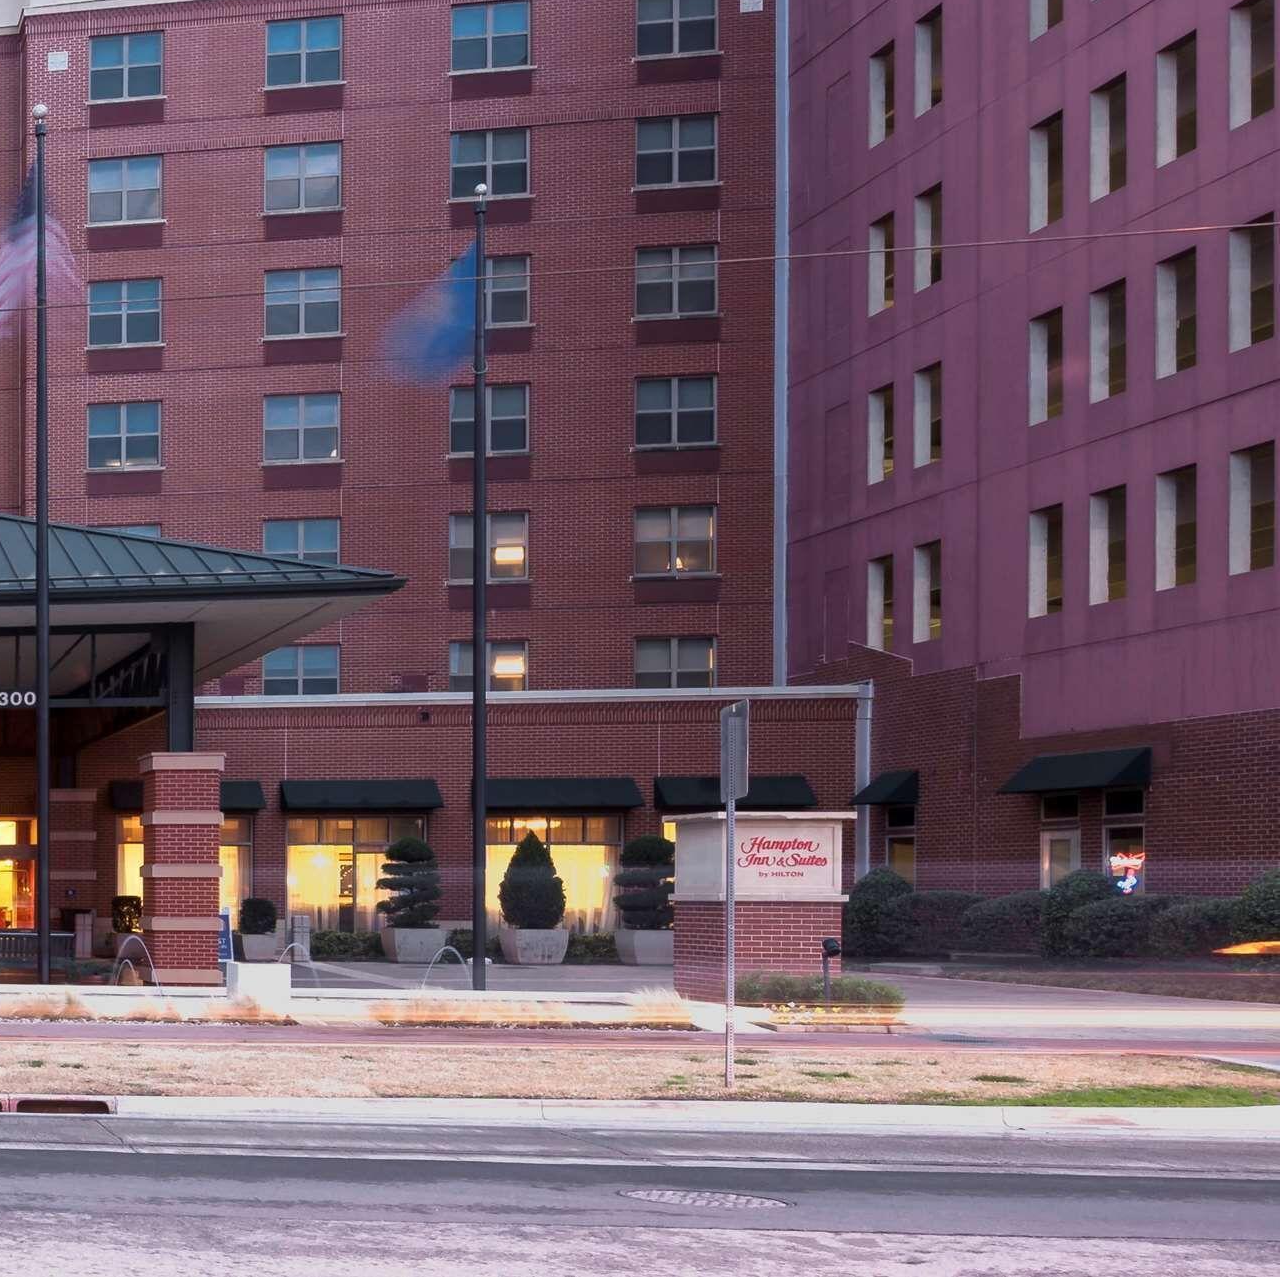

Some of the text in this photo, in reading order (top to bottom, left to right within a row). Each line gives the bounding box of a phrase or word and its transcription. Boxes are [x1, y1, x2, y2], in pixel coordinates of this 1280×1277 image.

[741, 836, 820, 853] Hampton
[737, 854, 827, 867] Inn & Suites
